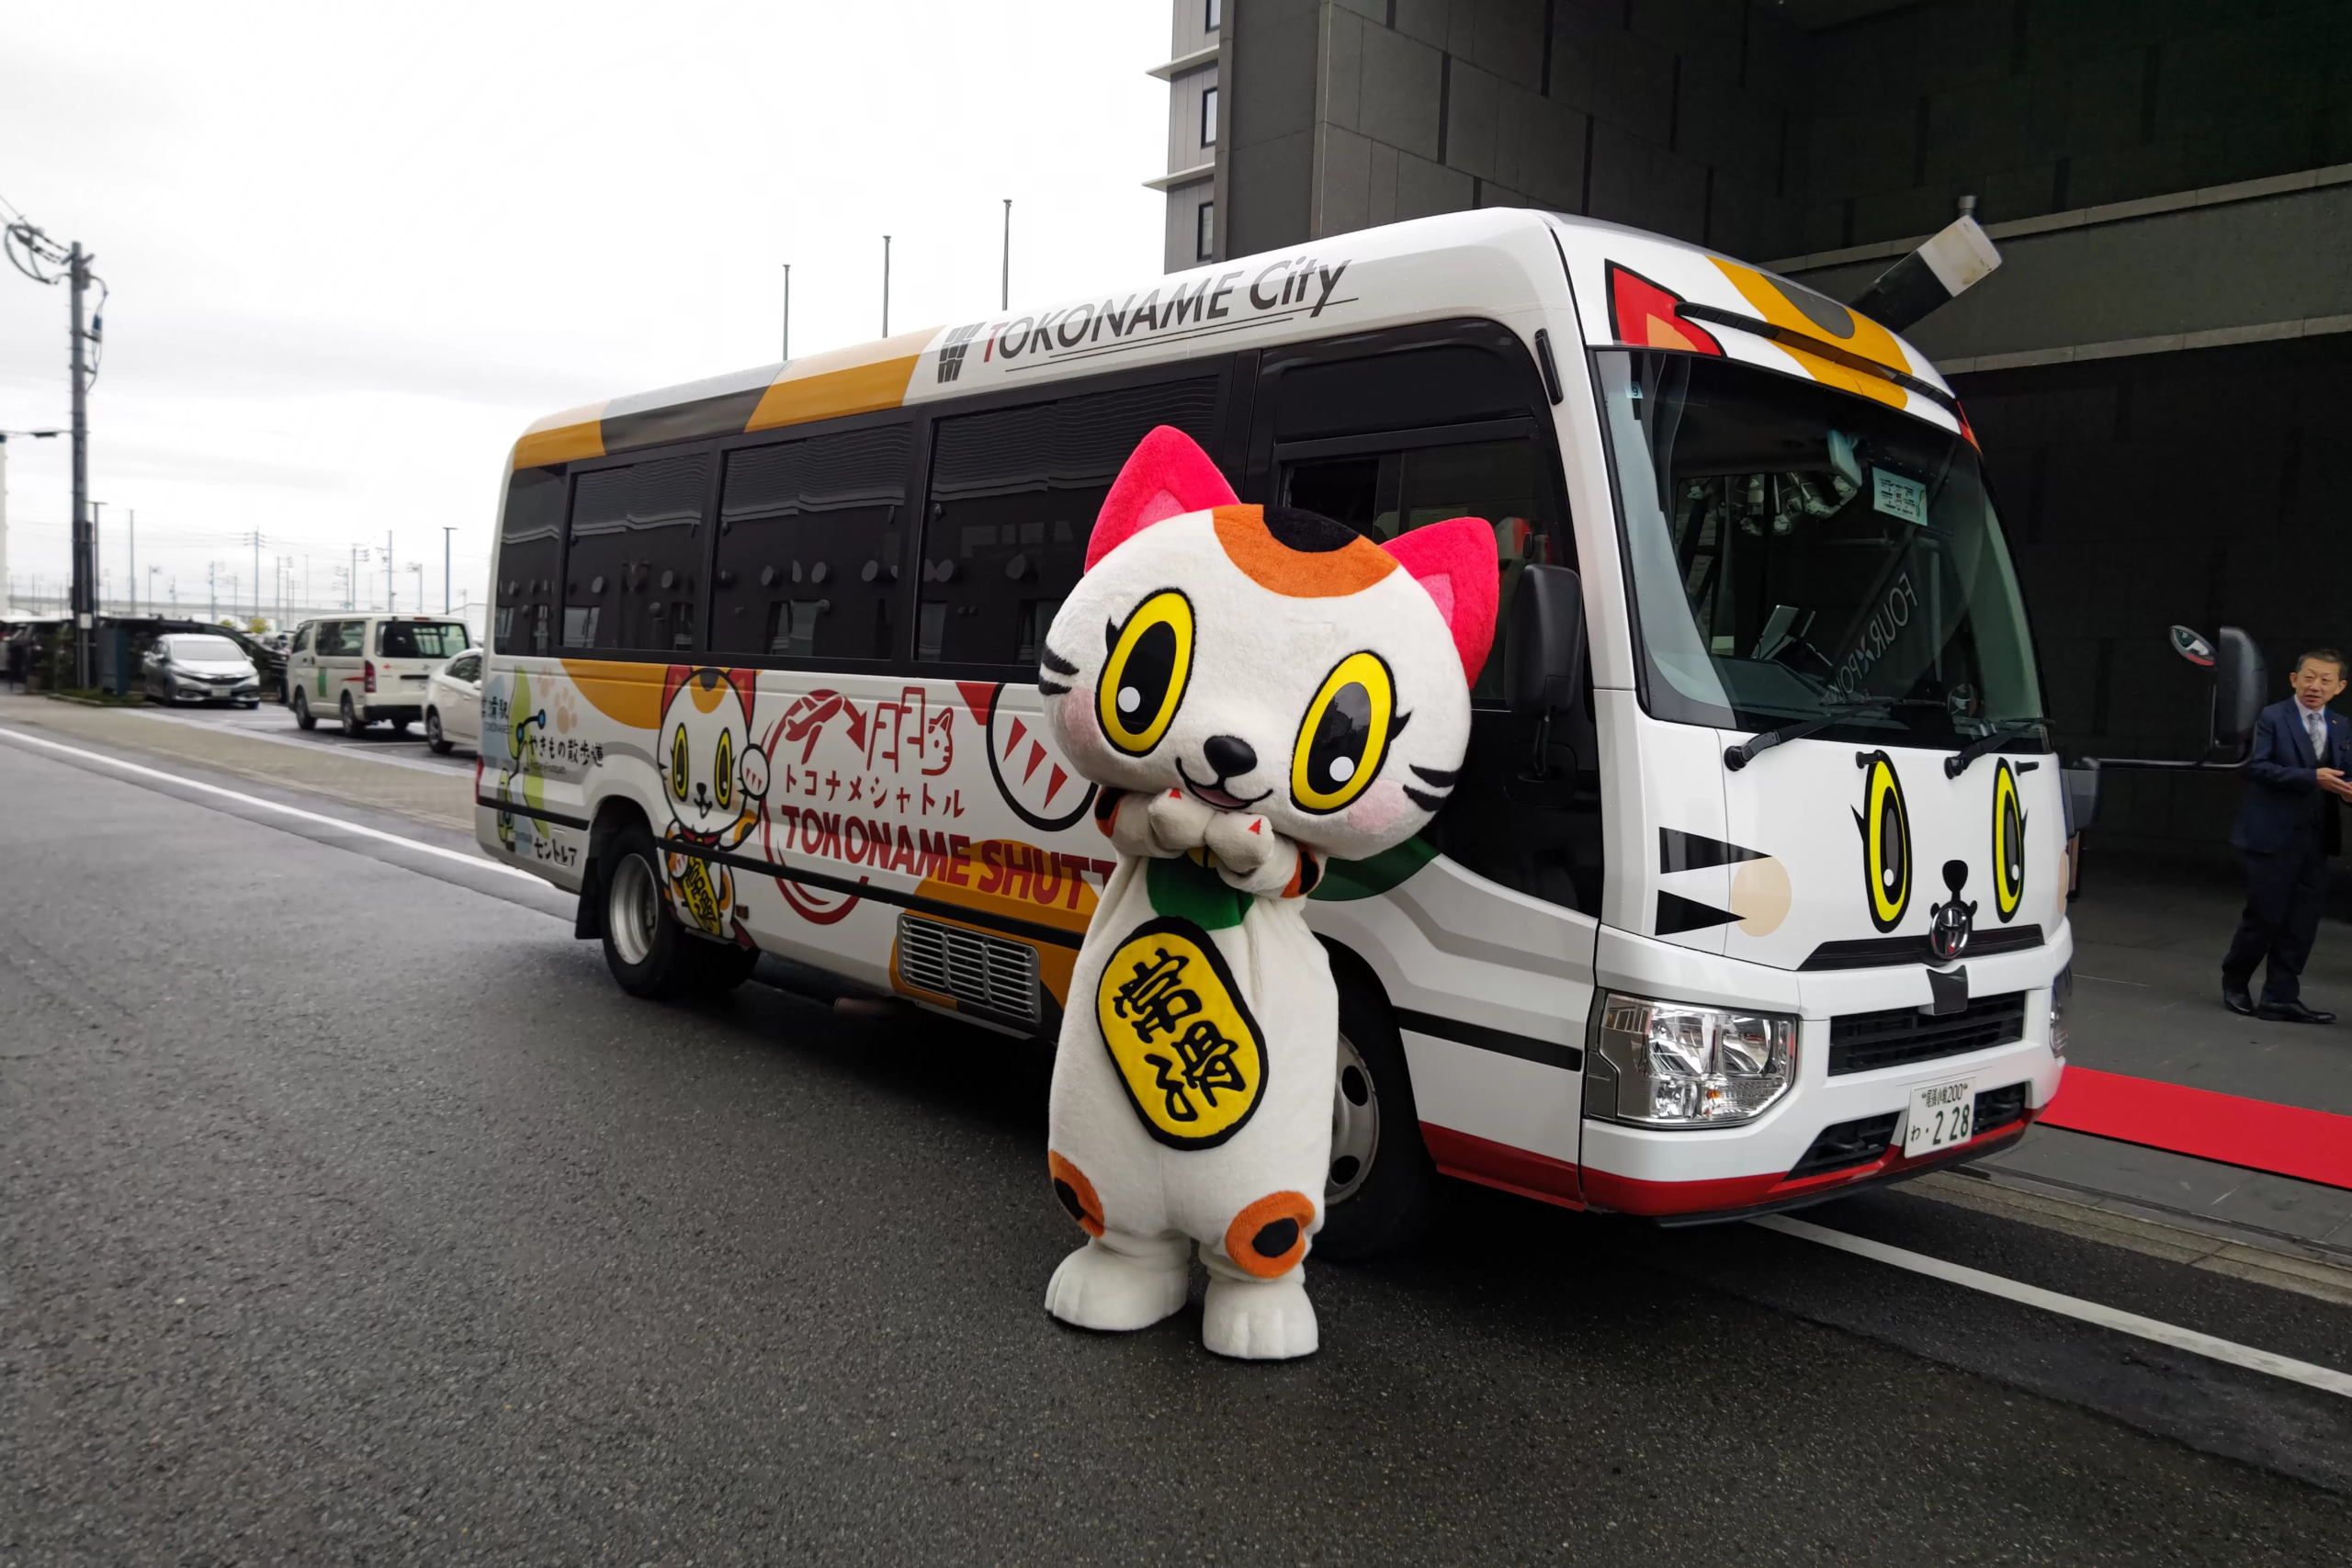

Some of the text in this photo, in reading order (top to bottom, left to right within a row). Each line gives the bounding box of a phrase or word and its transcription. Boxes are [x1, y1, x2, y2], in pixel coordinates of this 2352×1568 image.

[984, 255, 1353, 363] TOKONAME City
[529, 735, 604, 768] やきもの散歩道
[786, 763, 966, 818] トコナメシャトル
[534, 837, 577, 867] セントレア
[781, 805, 971, 888] TOKONAME
